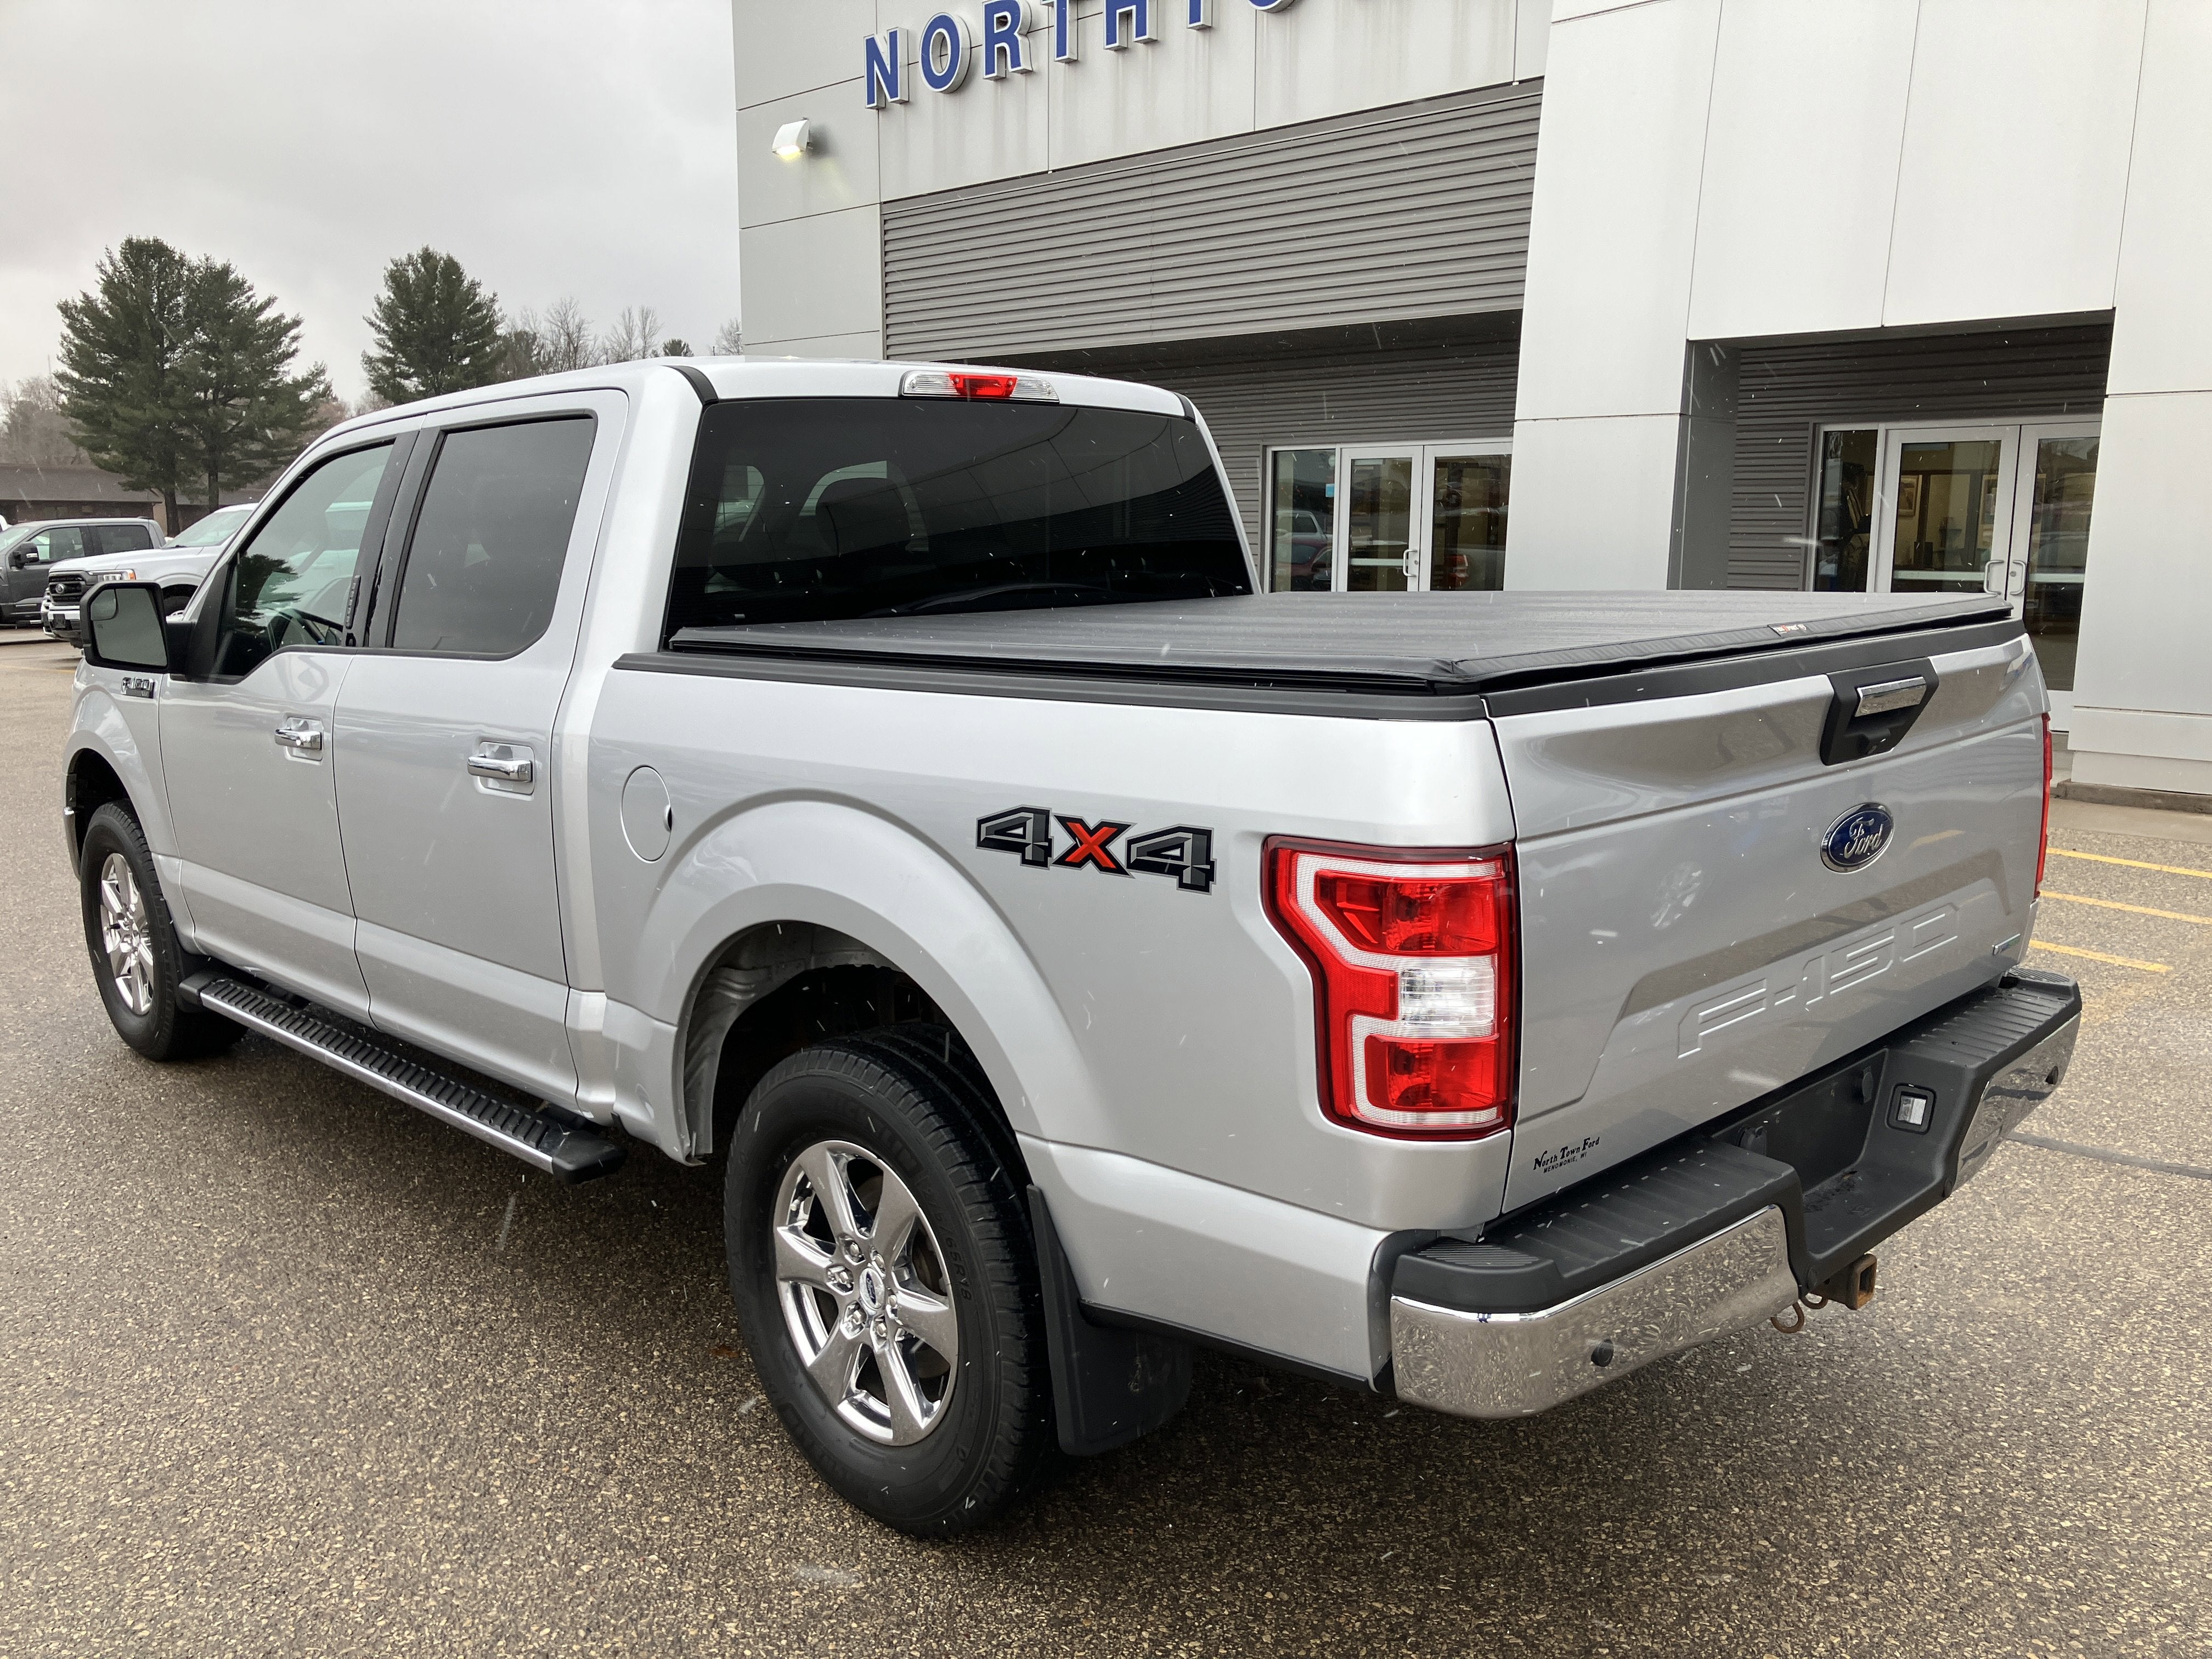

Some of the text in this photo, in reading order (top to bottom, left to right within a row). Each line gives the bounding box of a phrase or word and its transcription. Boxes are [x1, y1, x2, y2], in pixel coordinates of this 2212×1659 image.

[863, 0, 1296, 109] NORTH
[1844, 816, 1884, 859] Ford
[1677, 902, 1960, 1059] F-150
[1533, 1136, 1600, 1171] North Town Ford
